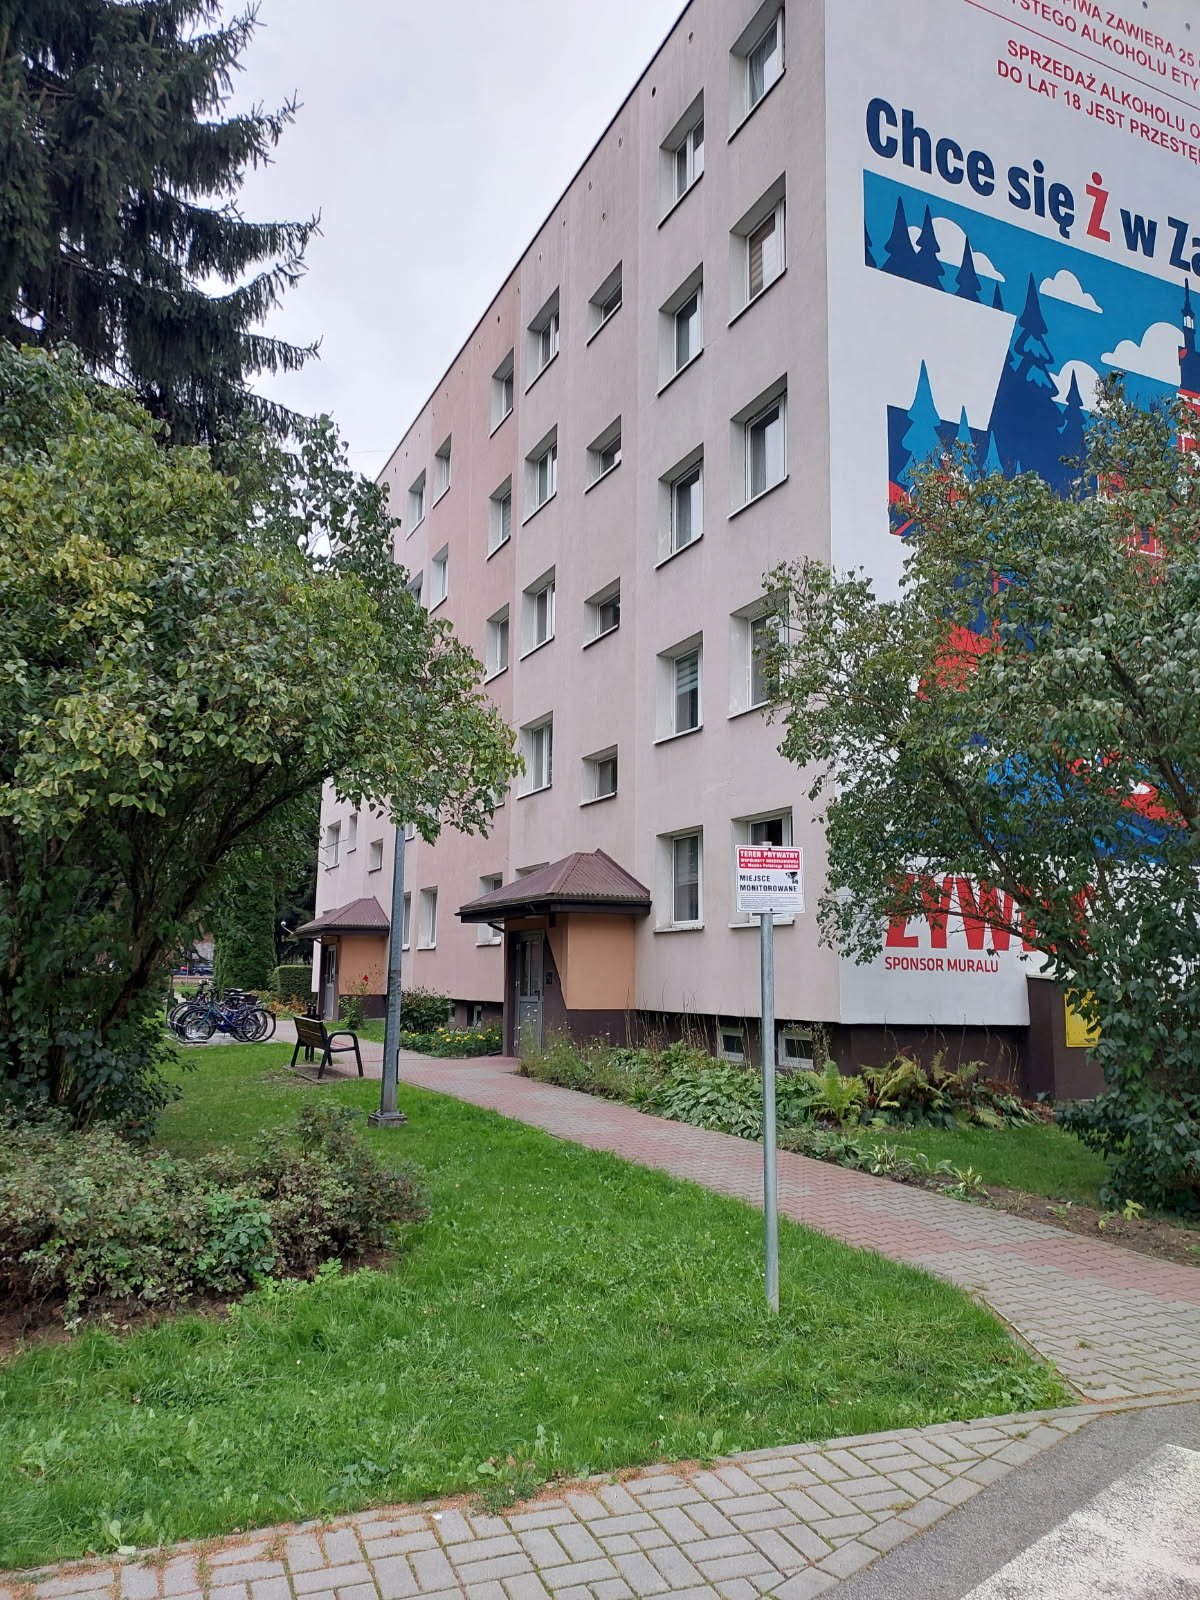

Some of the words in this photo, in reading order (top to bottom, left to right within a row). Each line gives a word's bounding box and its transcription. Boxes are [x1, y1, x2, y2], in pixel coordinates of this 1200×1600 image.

[1081, 24, 1167, 76] ALKOHOLU
[1105, 12, 1175, 59] ZAWIERA
[1178, 48, 1195, 67] 25
[1007, 39, 1096, 93] SPRZEDAŻ
[1100, 82, 1185, 132] ALKOHOLU
[997, 59, 1023, 84] DO
[1028, 73, 1058, 99] LAT
[1063, 90, 1081, 111] 18
[1085, 101, 1125, 129] JEST
[1130, 118, 1200, 166] PRZESTĘ
[866, 97, 995, 197] Chce
[1007, 159, 1075, 240] się
[1085, 171, 1111, 243] Ż
[1119, 207, 1158, 258] w
[739, 874, 770, 882] MIEJSCE
[740, 850, 761, 858] TEREN
[763, 851, 798, 859] PRYWATNY
[739, 884, 798, 892] MONITOROWANE
[884, 956, 944, 972] SPONSOR
[947, 958, 999, 973] MURALU
